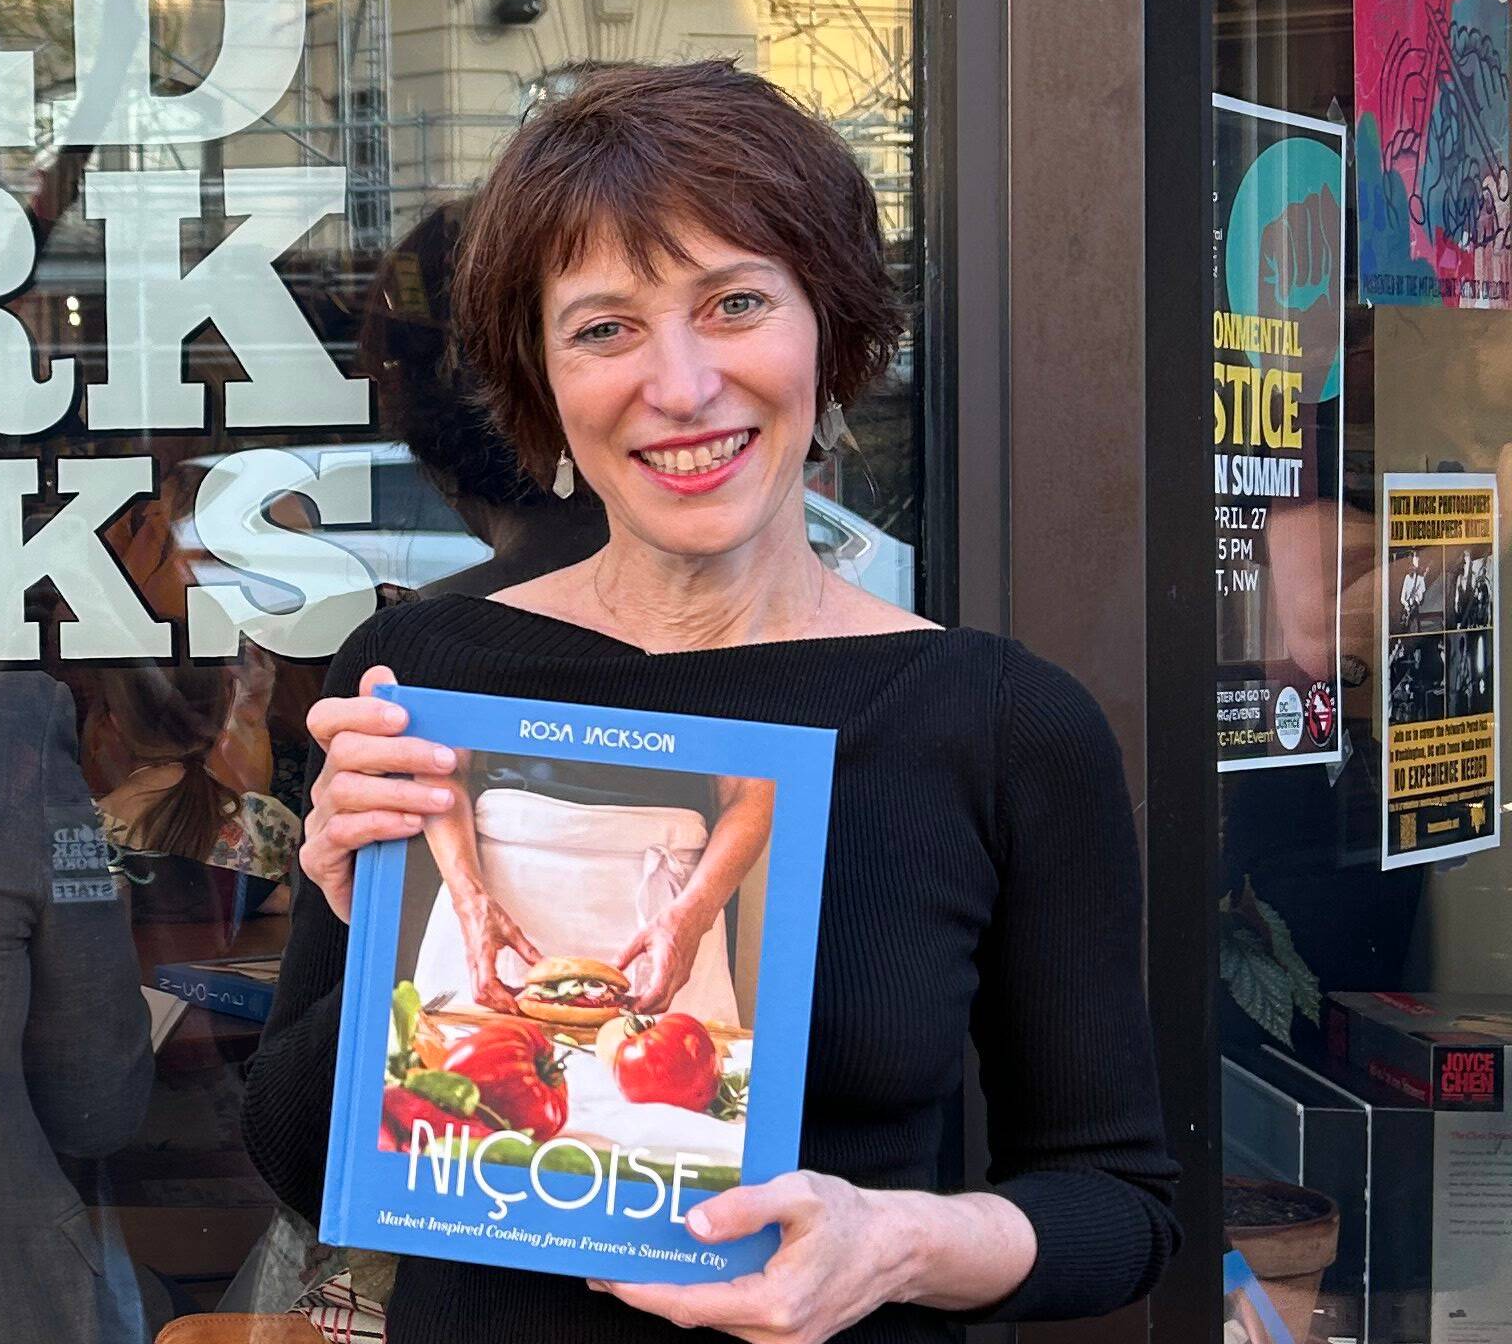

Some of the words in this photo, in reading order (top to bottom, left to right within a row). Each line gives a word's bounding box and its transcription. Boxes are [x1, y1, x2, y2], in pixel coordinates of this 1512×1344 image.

[1232, 455, 1303, 497] SUMMIT
[1251, 508, 1267, 530] 27
[1218, 538, 1227, 560] 5
[1231, 538, 1253, 560] PM
[1232, 570, 1259, 591] NW
[1235, 690, 1246, 702] OR
[1247, 689, 1259, 701] GO
[1259, 689, 1270, 701] TO
[519, 719, 573, 744] ROSA
[584, 724, 676, 754] JACKSON
[1248, 729, 1274, 745] Event
[1394, 768, 1405, 792] NO
[1409, 759, 1459, 790] EXPERIENCE
[1461, 755, 1487, 781] NEEDED
[1442, 1052, 1494, 1072] JOYCE
[1441, 1072, 1494, 1093] CHEN
[407, 1118, 706, 1224] NIÇOISE
[377, 1209, 425, 1230] Market
[427, 1217, 485, 1237] Inspired
[486, 1224, 543, 1248] Cooking
[541, 1231, 576, 1249] from
[580, 1235, 636, 1256] France's
[638, 1242, 697, 1264] Sunniest
[700, 1251, 729, 1270] City
